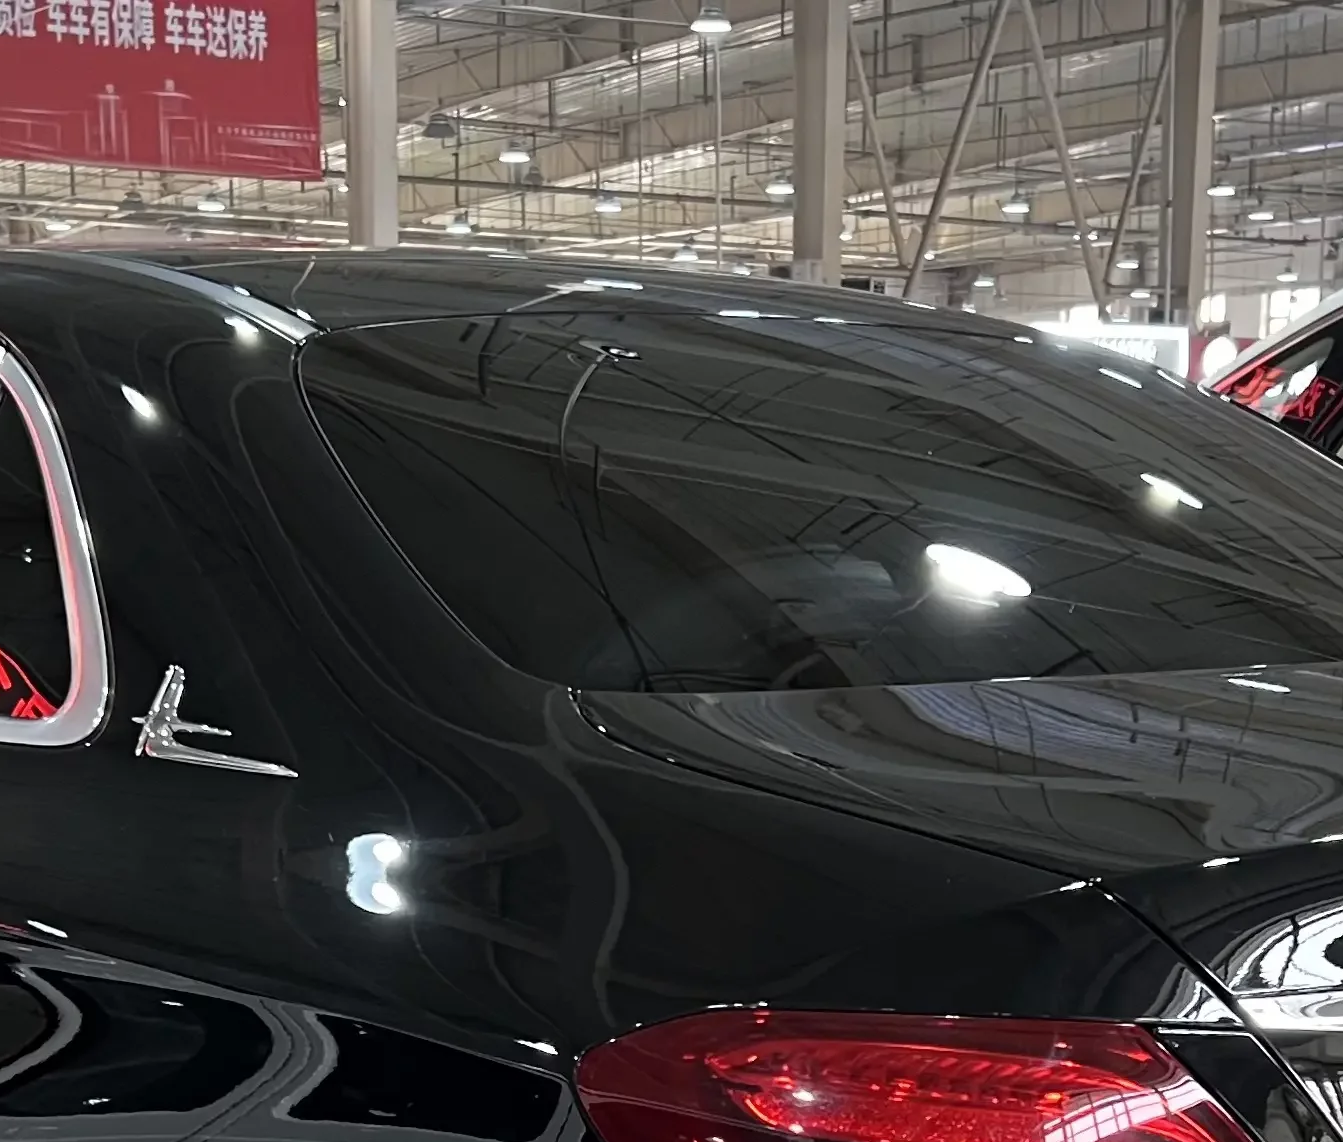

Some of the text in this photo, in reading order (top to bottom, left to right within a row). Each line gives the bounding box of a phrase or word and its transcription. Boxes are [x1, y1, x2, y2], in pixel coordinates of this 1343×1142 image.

[46, 0, 155, 51] 车车有保障
[164, 2, 268, 62] 车车送保养
